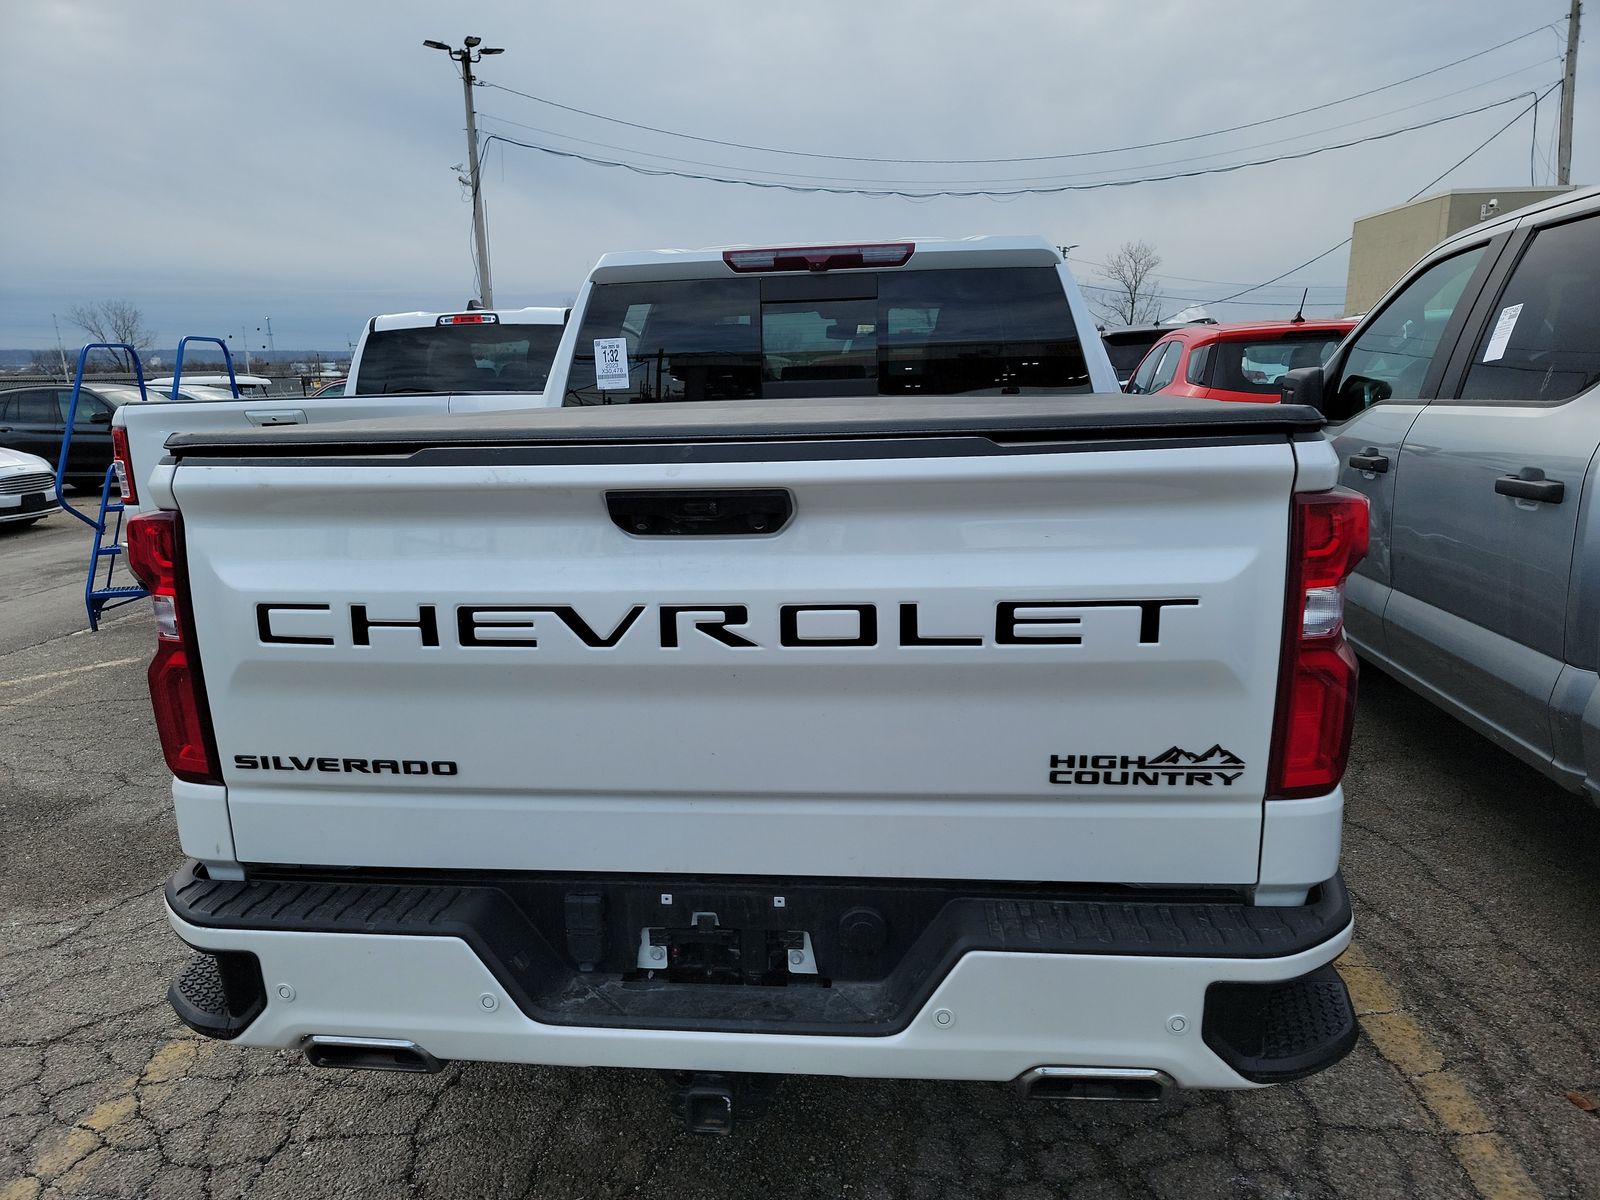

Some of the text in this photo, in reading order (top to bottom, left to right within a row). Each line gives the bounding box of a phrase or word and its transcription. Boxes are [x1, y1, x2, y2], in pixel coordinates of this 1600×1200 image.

[603, 349, 619, 362] 1:32
[256, 598, 1199, 648] CHEVROLET
[234, 754, 458, 777] SILVERADO
[1049, 753, 1146, 770] HIGH
[1049, 769, 1245, 787] COUNTRY
